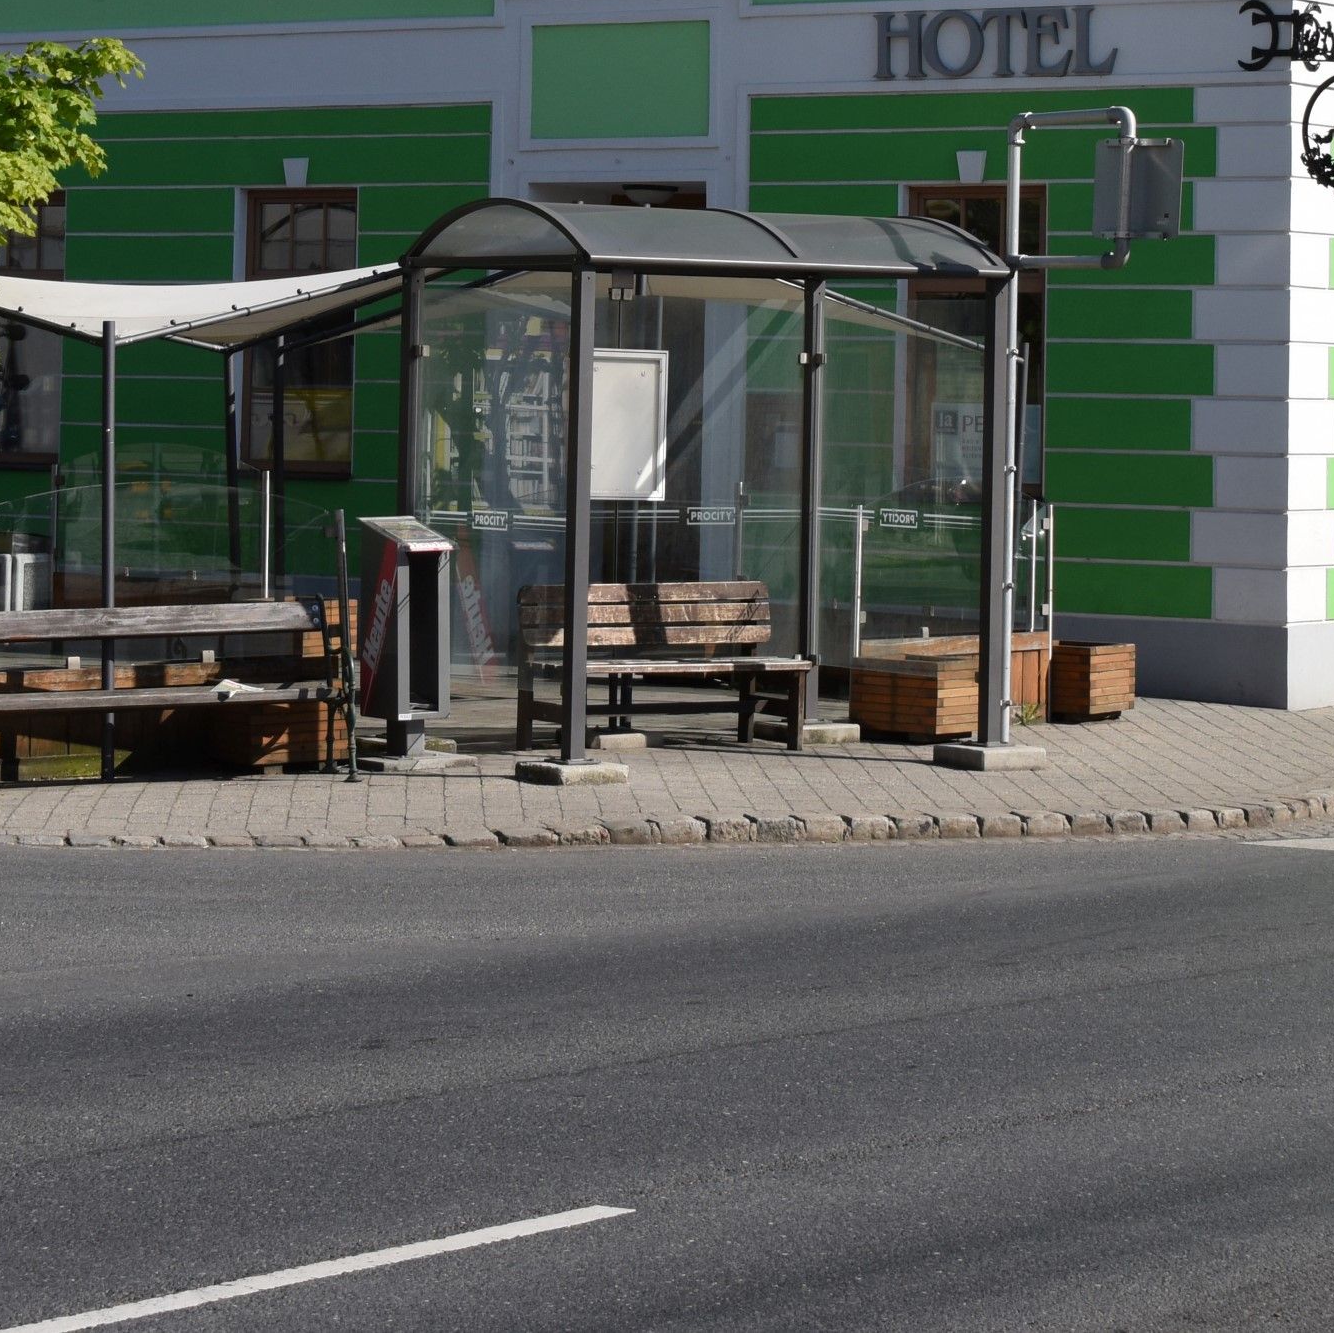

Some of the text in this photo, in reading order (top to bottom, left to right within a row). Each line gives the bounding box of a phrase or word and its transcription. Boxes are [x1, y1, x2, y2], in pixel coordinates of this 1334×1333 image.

[873, 5, 1118, 81] HOTEL
[475, 514, 506, 527] PROCITY
[690, 510, 733, 522] PROCITY
[362, 578, 392, 670] Heute
